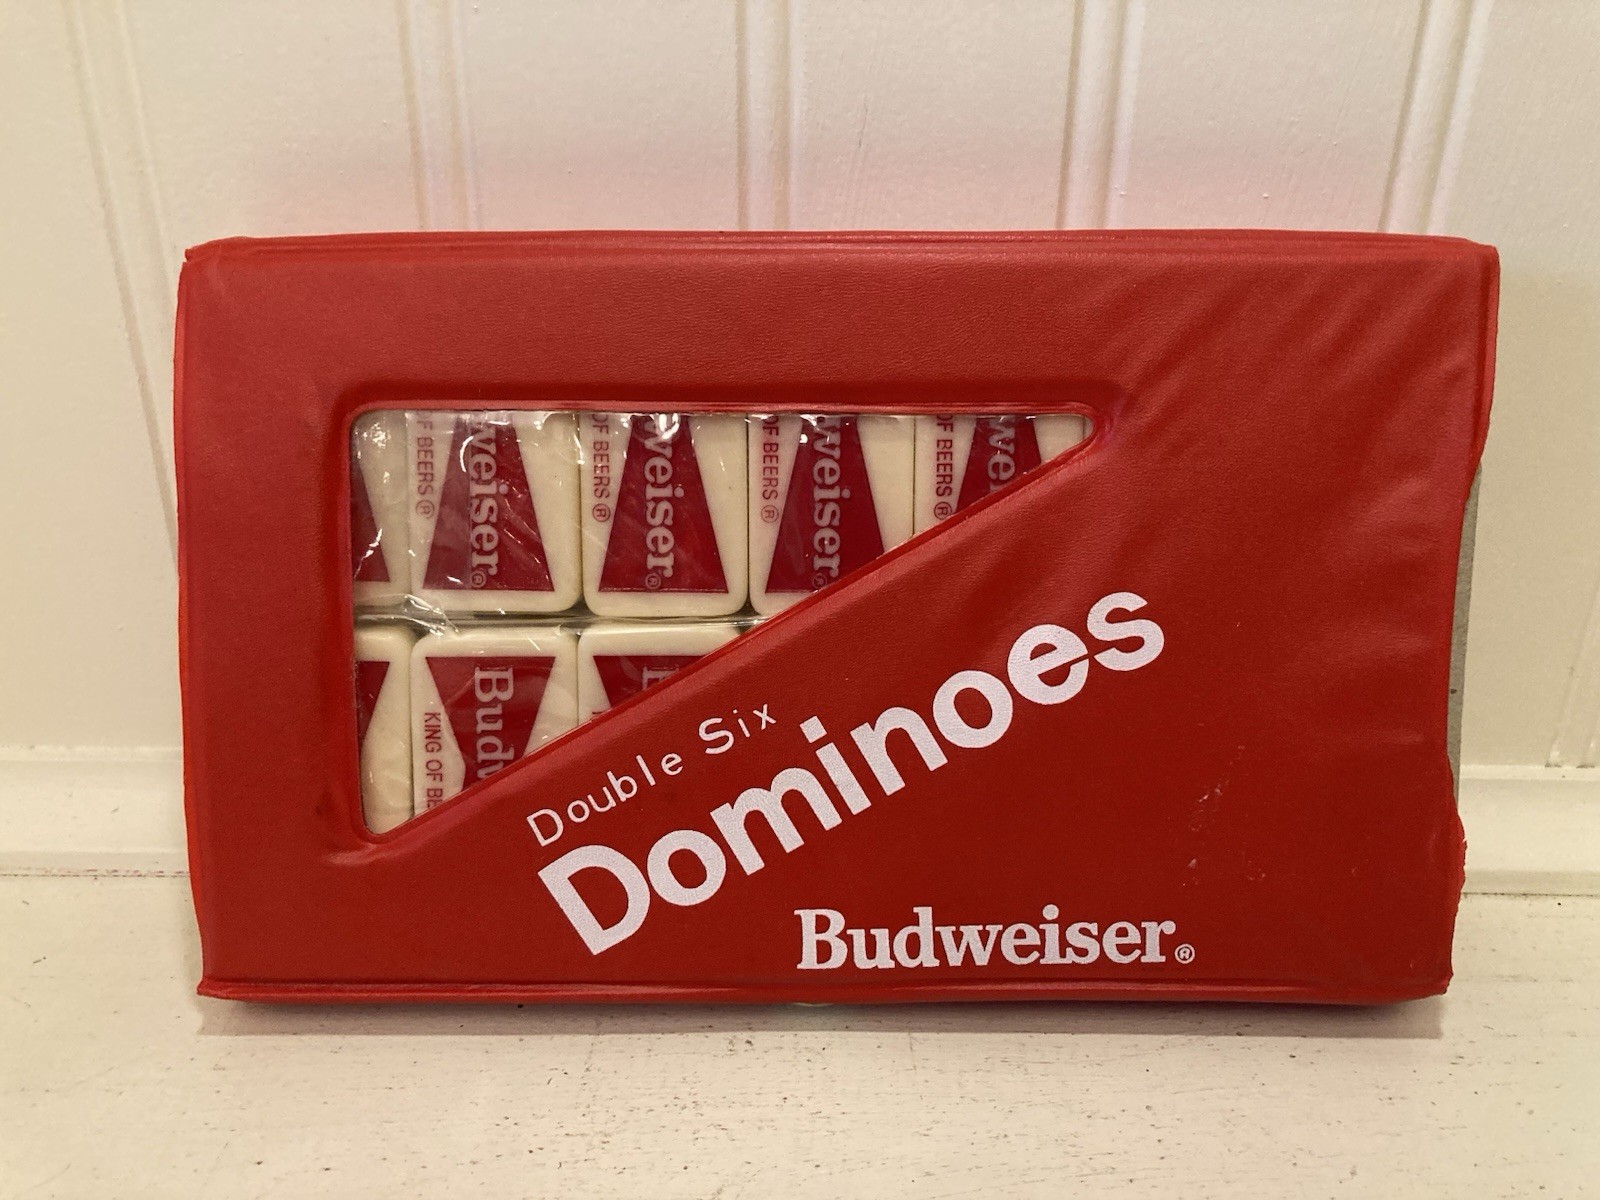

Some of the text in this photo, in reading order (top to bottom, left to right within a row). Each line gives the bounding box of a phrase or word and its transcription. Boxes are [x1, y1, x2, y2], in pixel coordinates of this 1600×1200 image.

[762, 442, 779, 500] BEERS
[936, 439, 953, 497] BEERS
[423, 712, 442, 753] KING
[425, 762, 443, 782] OF
[526, 703, 776, 847] Double Six
[537, 591, 1165, 956] Dominoes
